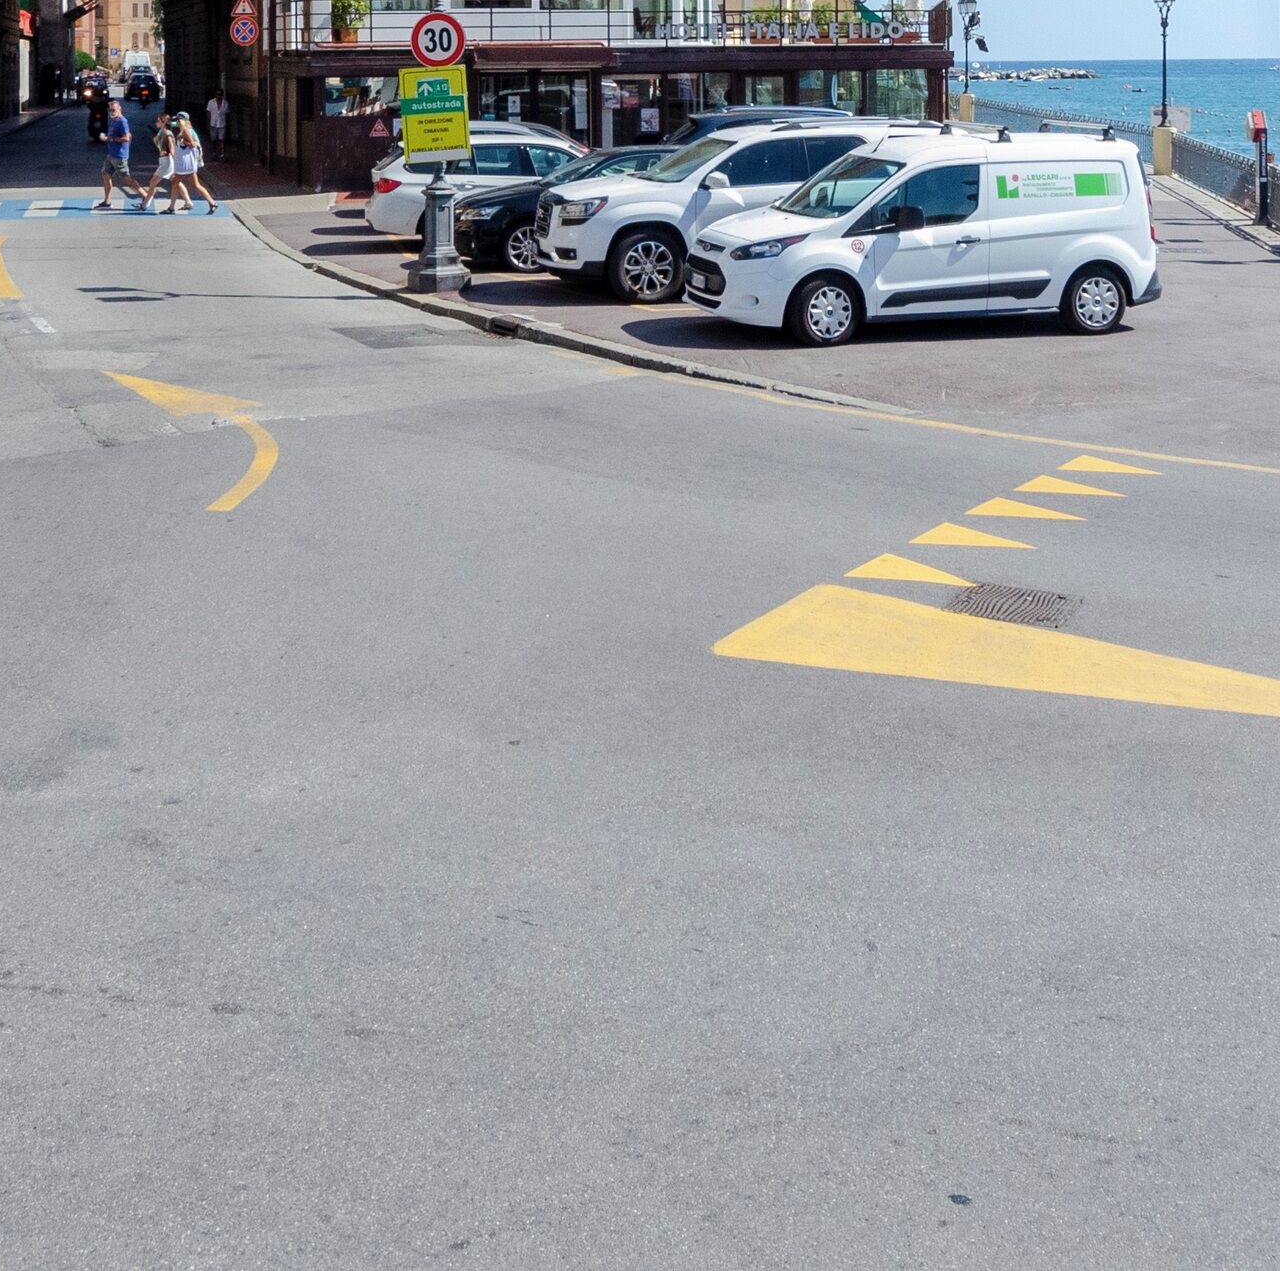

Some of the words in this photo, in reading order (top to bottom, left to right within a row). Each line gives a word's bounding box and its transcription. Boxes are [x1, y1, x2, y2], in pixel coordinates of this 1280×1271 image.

[655, 23, 732, 40] HOTEL
[744, 22, 820, 40] ITALIA
[828, 22, 839, 39] E
[848, 21, 904, 39] LIDO
[423, 27, 452, 53] 30
[411, 99, 461, 110] autostrada
[424, 117, 454, 125] DIREZIONE
[1026, 173, 1059, 181] LEUCARI
[853, 241, 862, 250] 12
